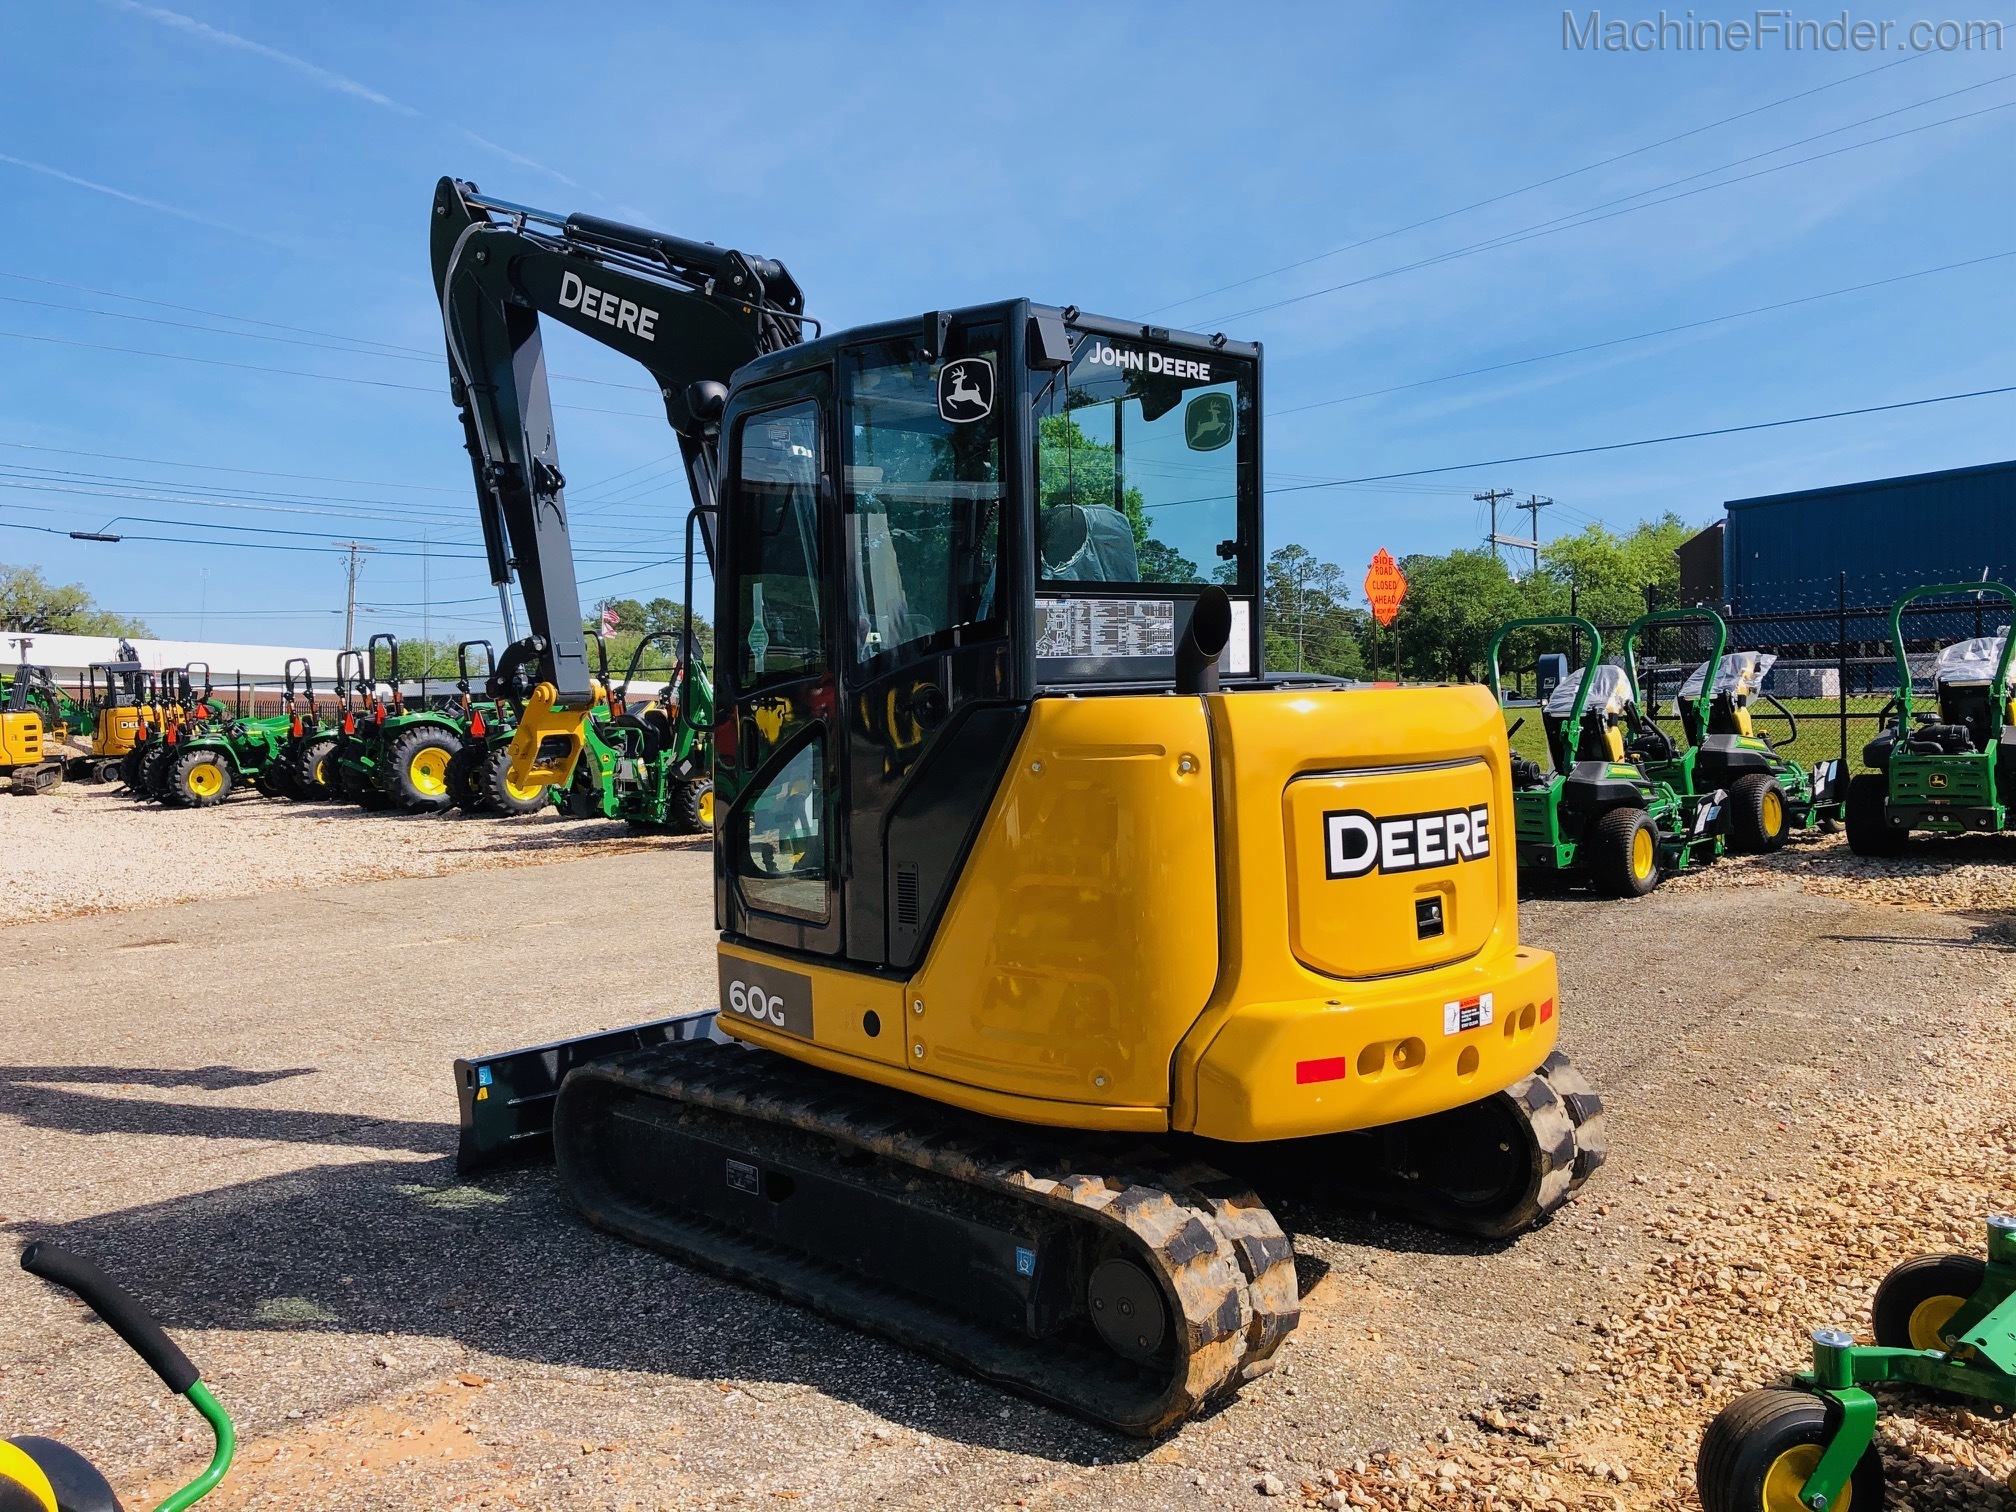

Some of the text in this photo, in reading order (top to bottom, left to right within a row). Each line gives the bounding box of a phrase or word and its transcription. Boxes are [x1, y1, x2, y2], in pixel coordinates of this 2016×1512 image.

[559, 271, 659, 341] DEERE
[1090, 342, 1210, 381] JOHN DEERE
[1373, 556, 1394, 566] SIDE
[1375, 566, 1393, 576] ROAD
[1372, 580, 1397, 590] CLOSED
[1374, 595, 1396, 605] AHEAD
[1326, 807, 1490, 875] DEERE
[729, 980, 785, 1027] 60G
